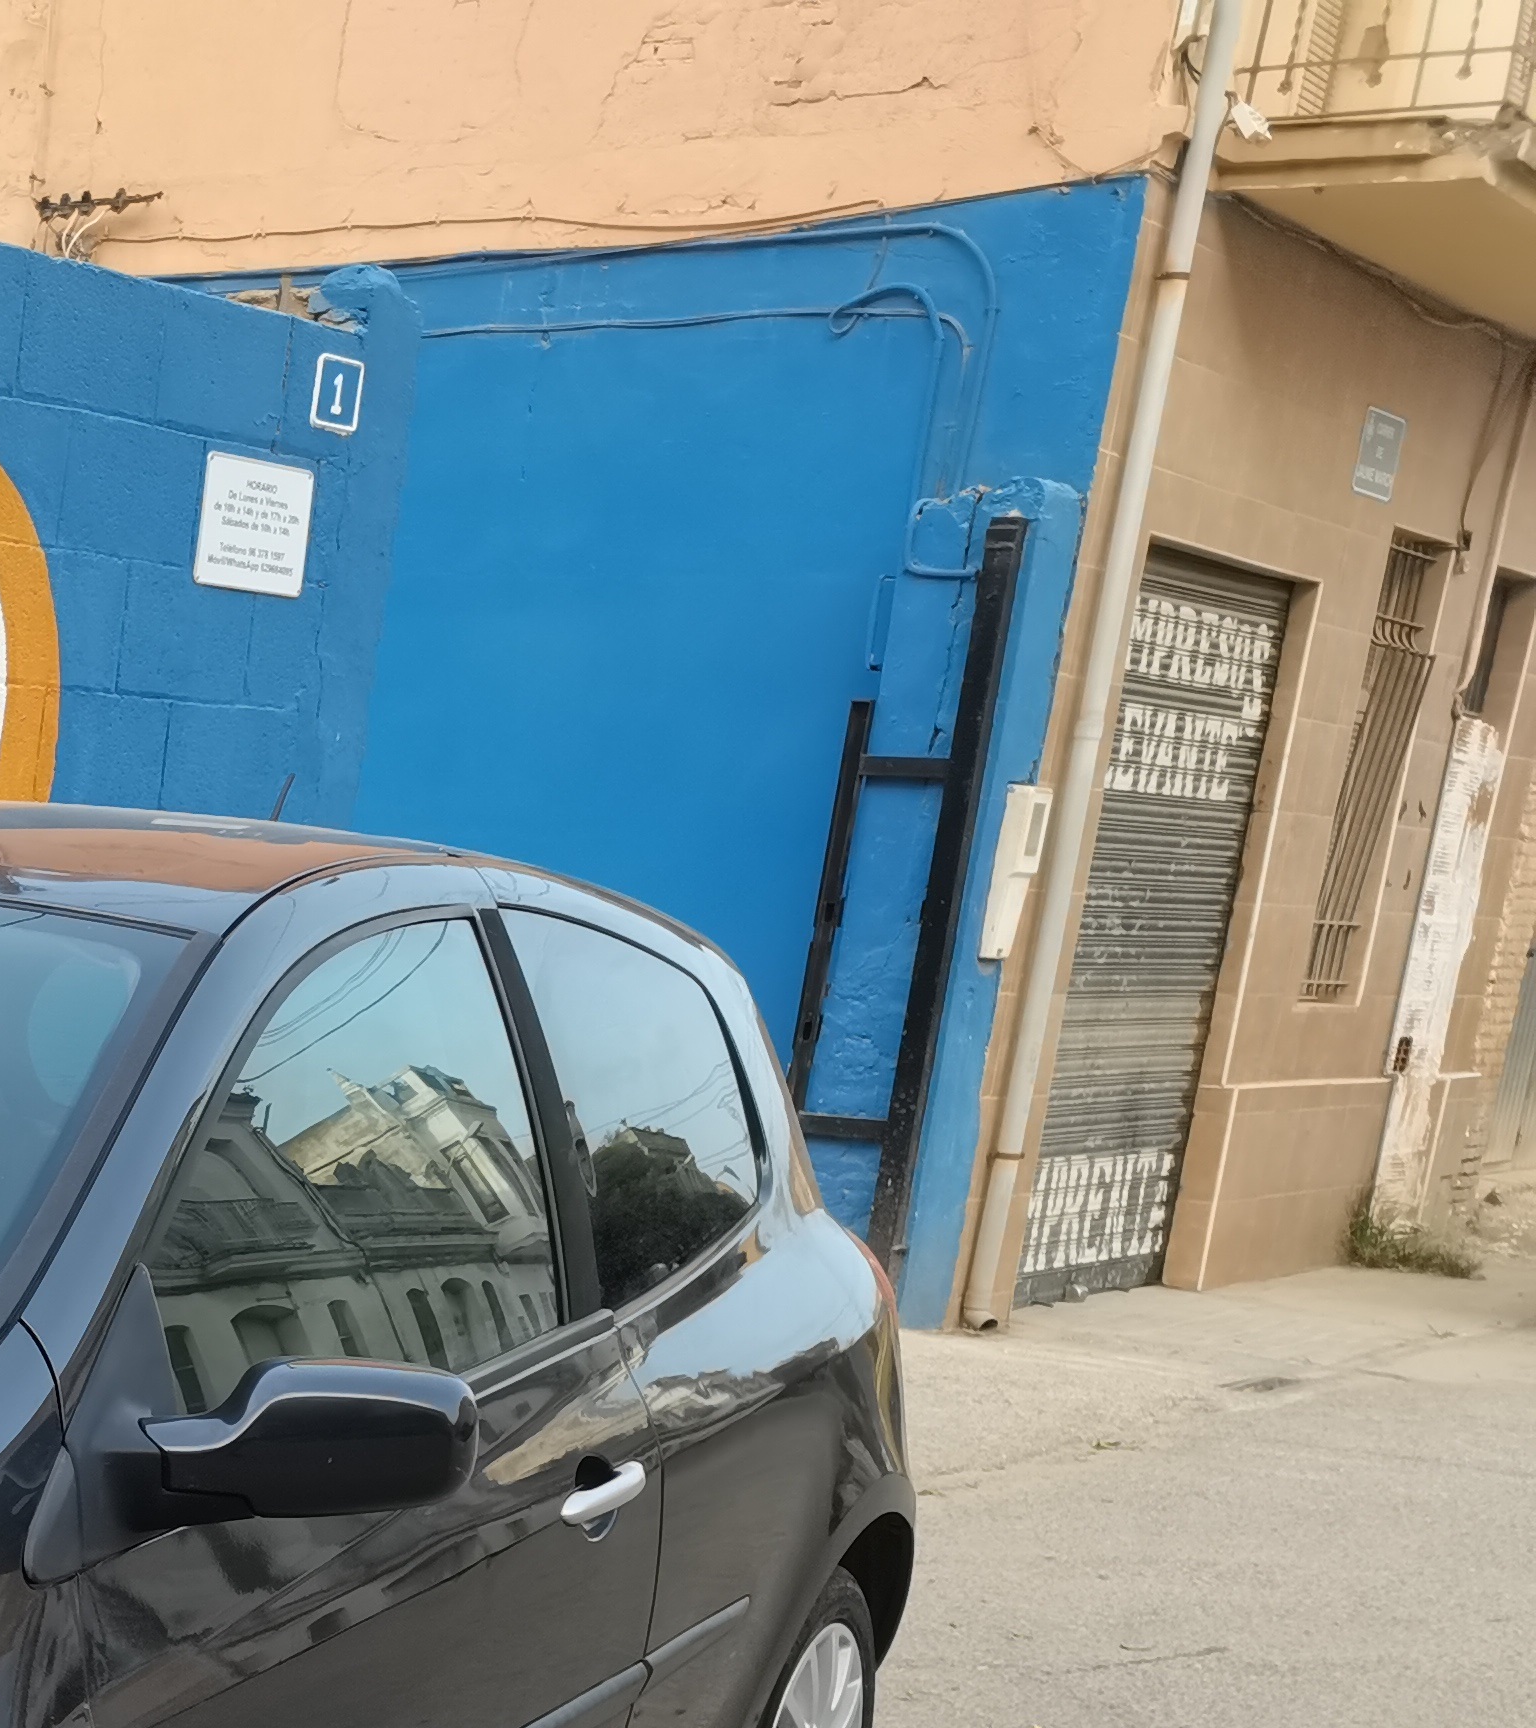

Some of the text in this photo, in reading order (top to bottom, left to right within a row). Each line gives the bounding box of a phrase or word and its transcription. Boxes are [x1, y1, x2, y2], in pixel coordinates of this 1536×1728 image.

[330, 372, 344, 415] 1
[246, 480, 278, 495] HORARIO
[228, 490, 237, 500] De
[239, 491, 258, 504] Lunes
